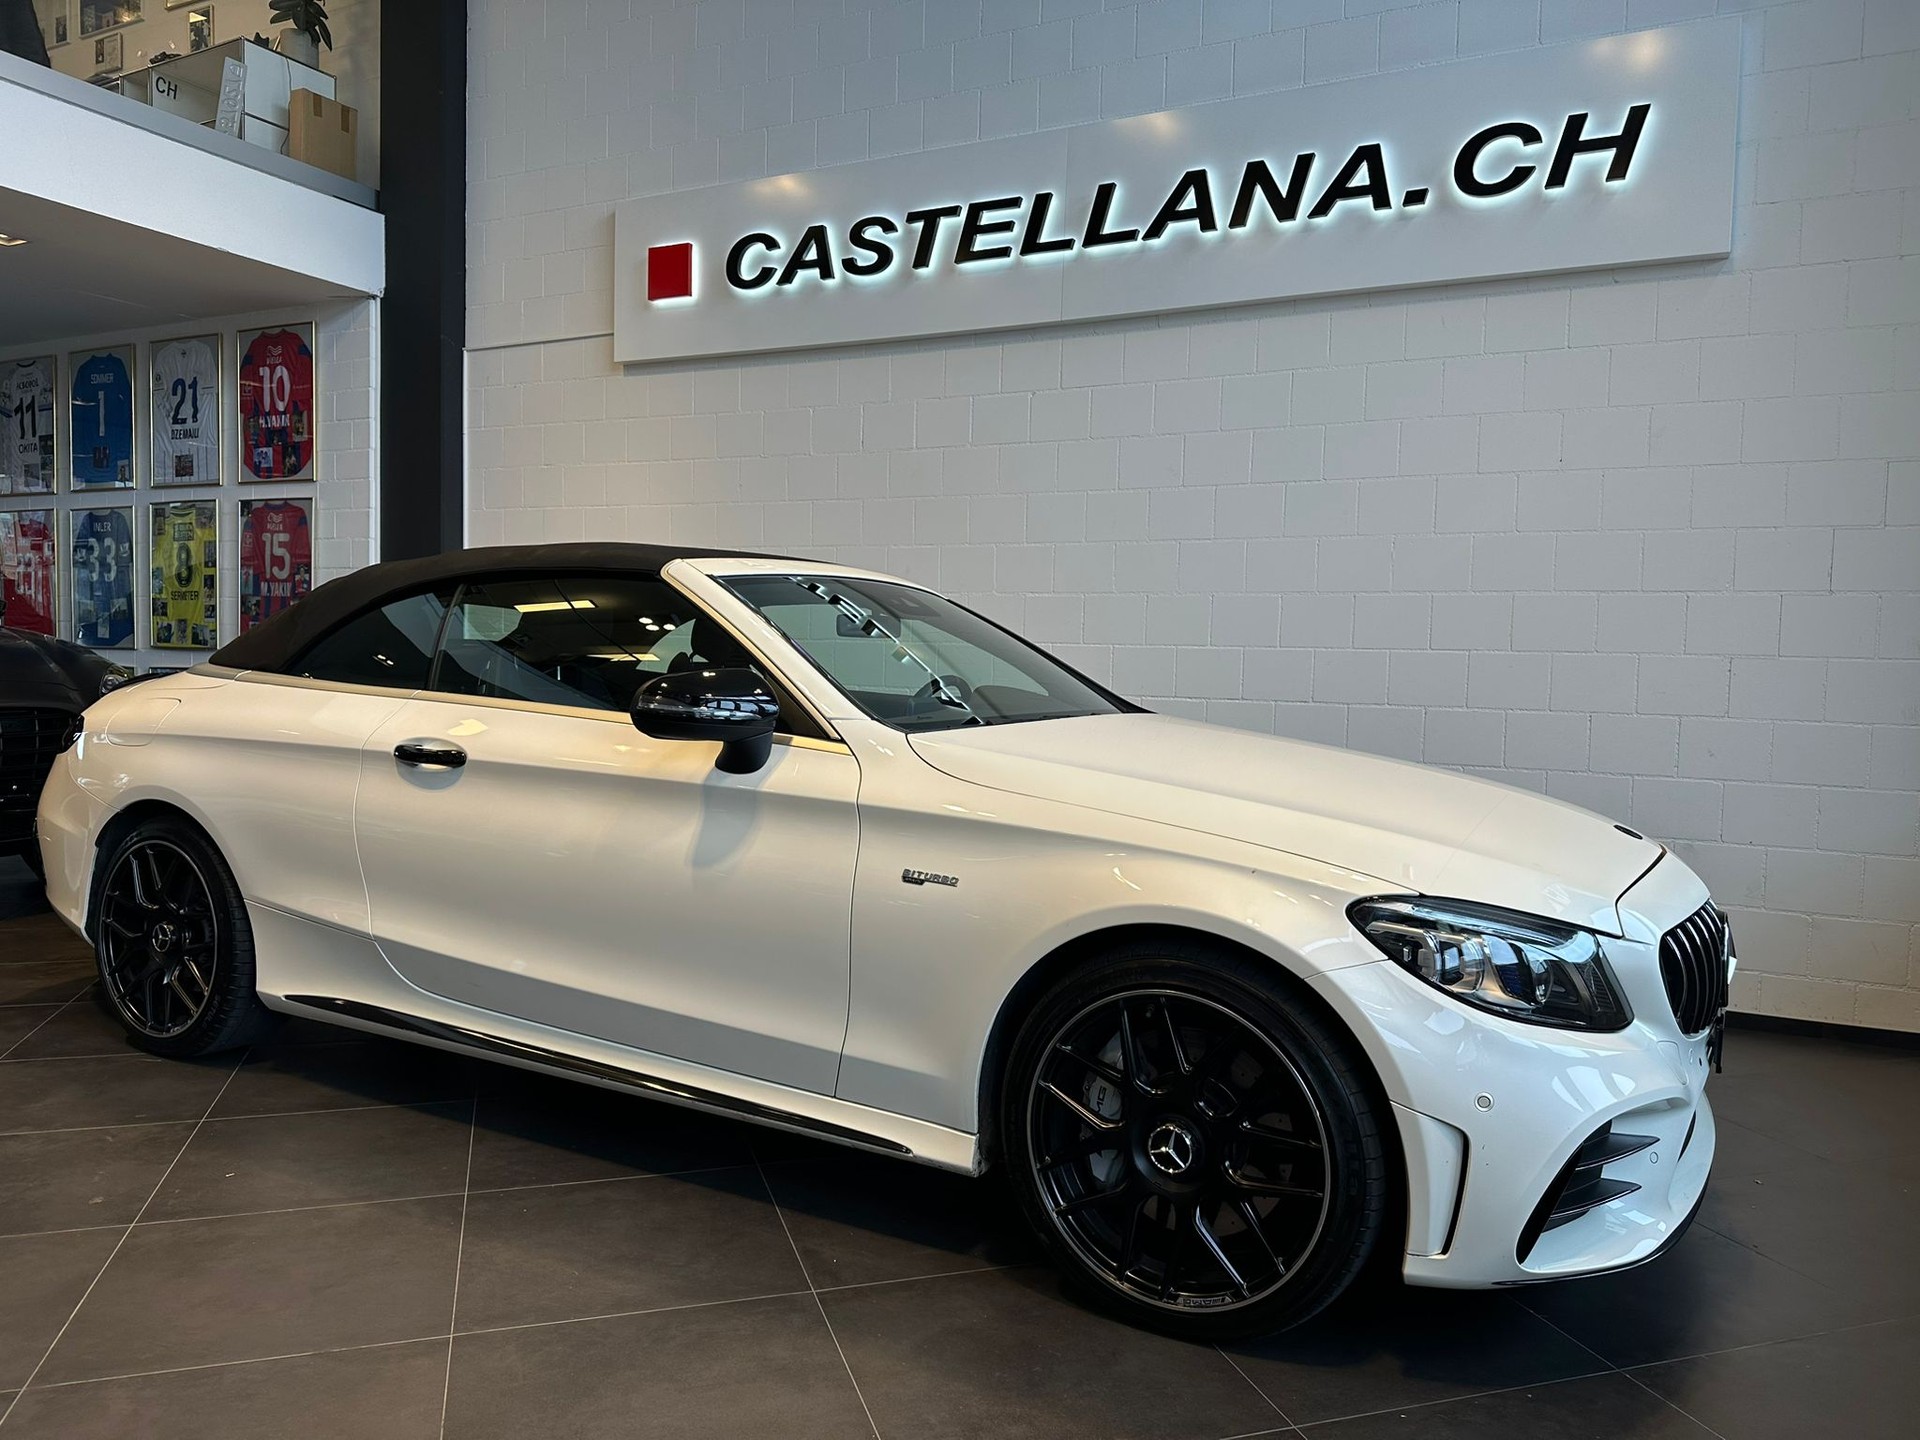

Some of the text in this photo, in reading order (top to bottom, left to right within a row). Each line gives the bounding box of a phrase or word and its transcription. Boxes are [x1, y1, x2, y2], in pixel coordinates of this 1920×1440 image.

[155, 76, 178, 100] CH
[725, 103, 1652, 290] CASTELLANA.CH
[90, 372, 114, 384] SOMMER
[171, 376, 199, 425] 21
[259, 365, 291, 412] 10
[13, 395, 37, 440] 11
[98, 390, 105, 437] 1
[18, 443, 38, 454] OKITA
[175, 542, 193, 588] 8
[262, 532, 291, 580] 15
[902, 867, 960, 885] BITURBO
